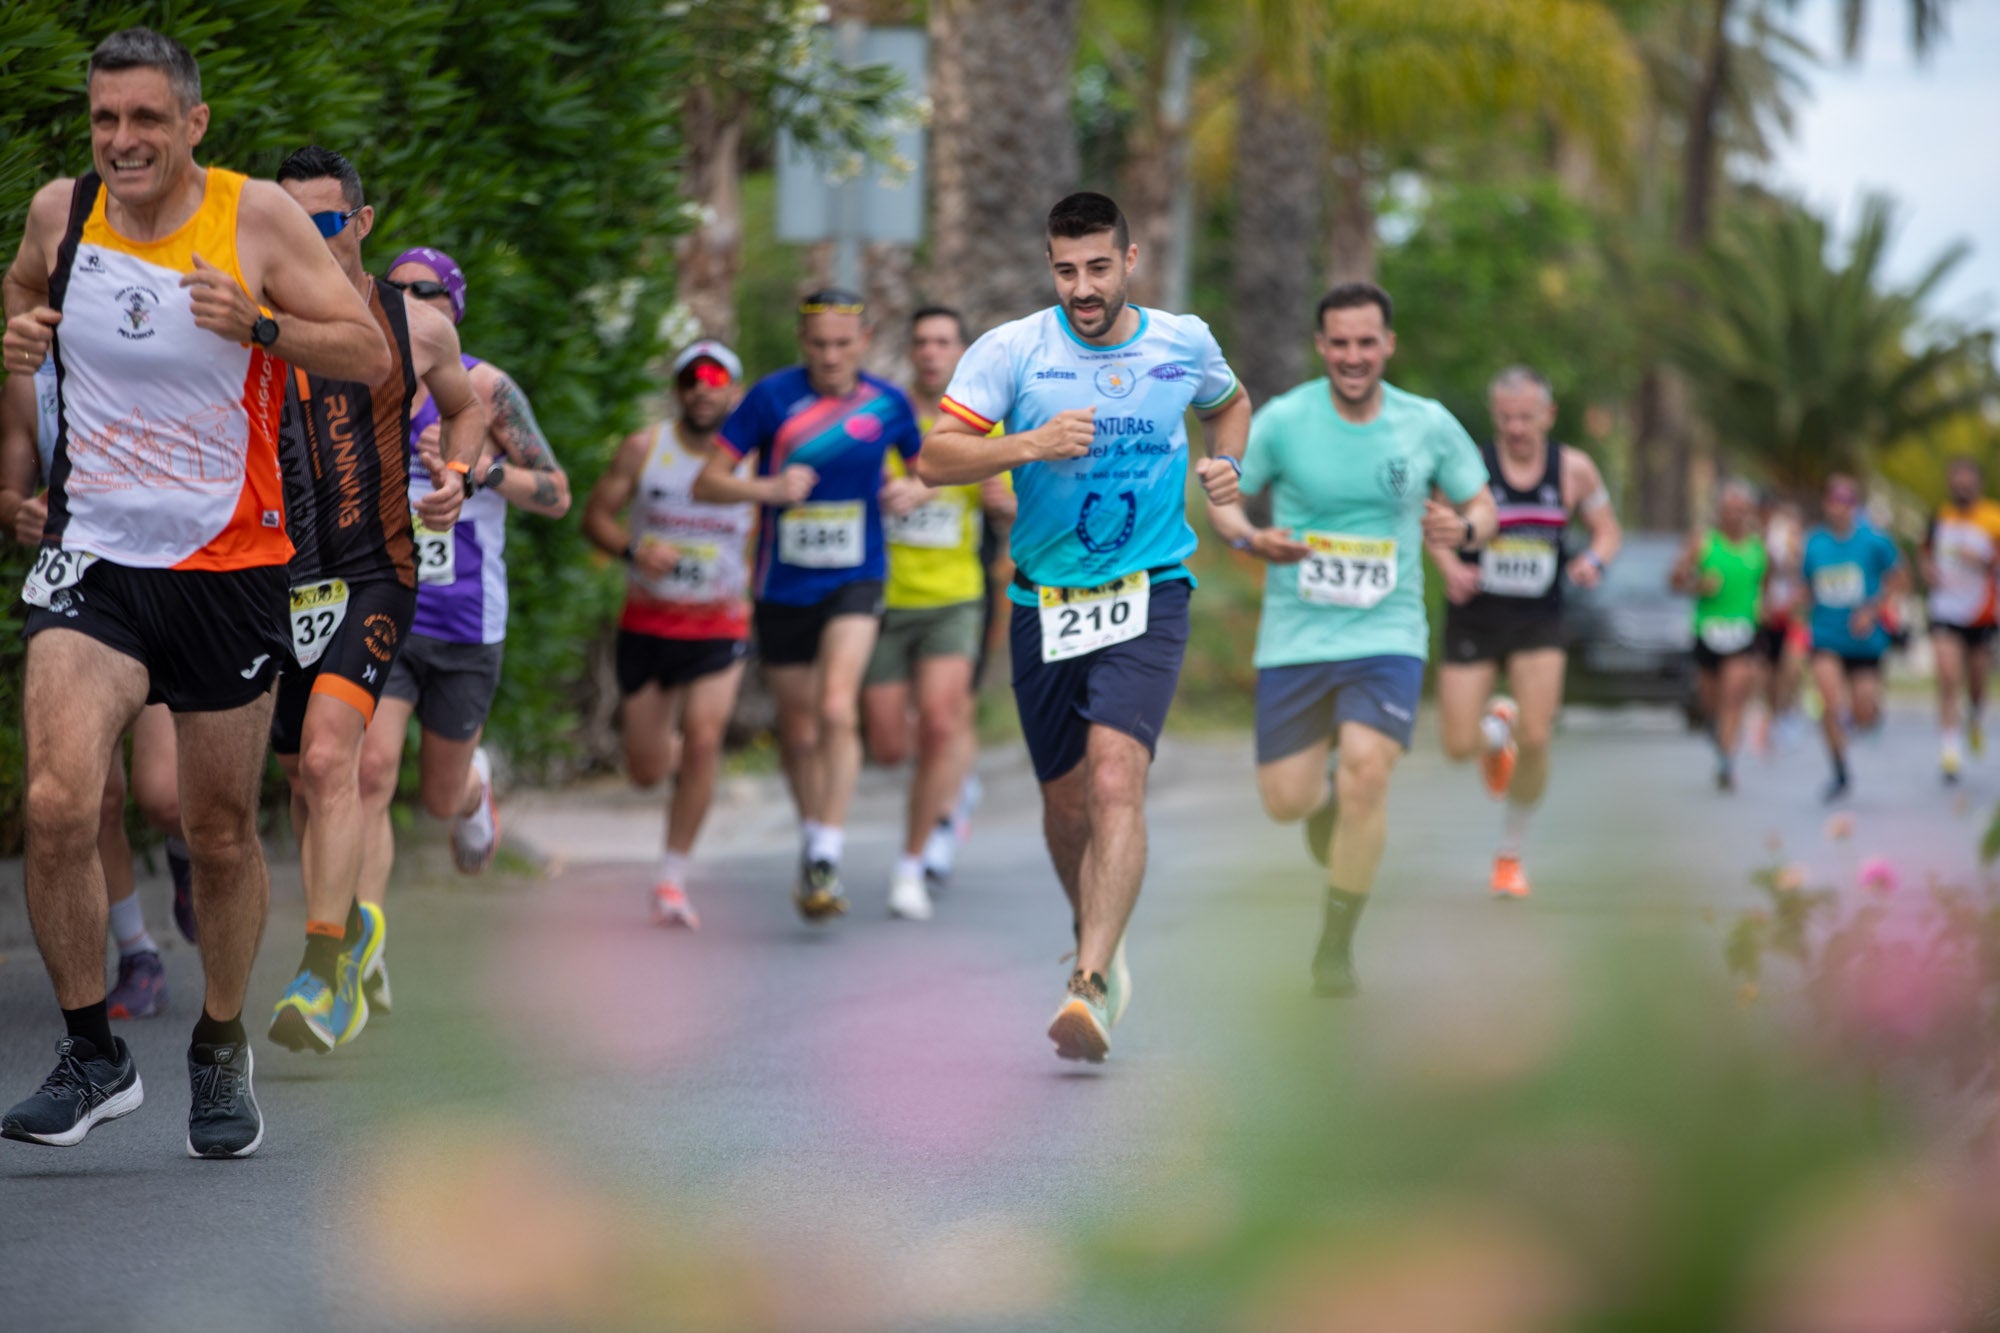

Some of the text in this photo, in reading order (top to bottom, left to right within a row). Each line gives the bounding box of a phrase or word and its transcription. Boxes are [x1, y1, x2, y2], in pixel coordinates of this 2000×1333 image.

[323, 394, 361, 529] RUNNING
[1306, 559, 1390, 589] 3378
[296, 611, 335, 646] 32
[1059, 601, 1130, 640] 210
